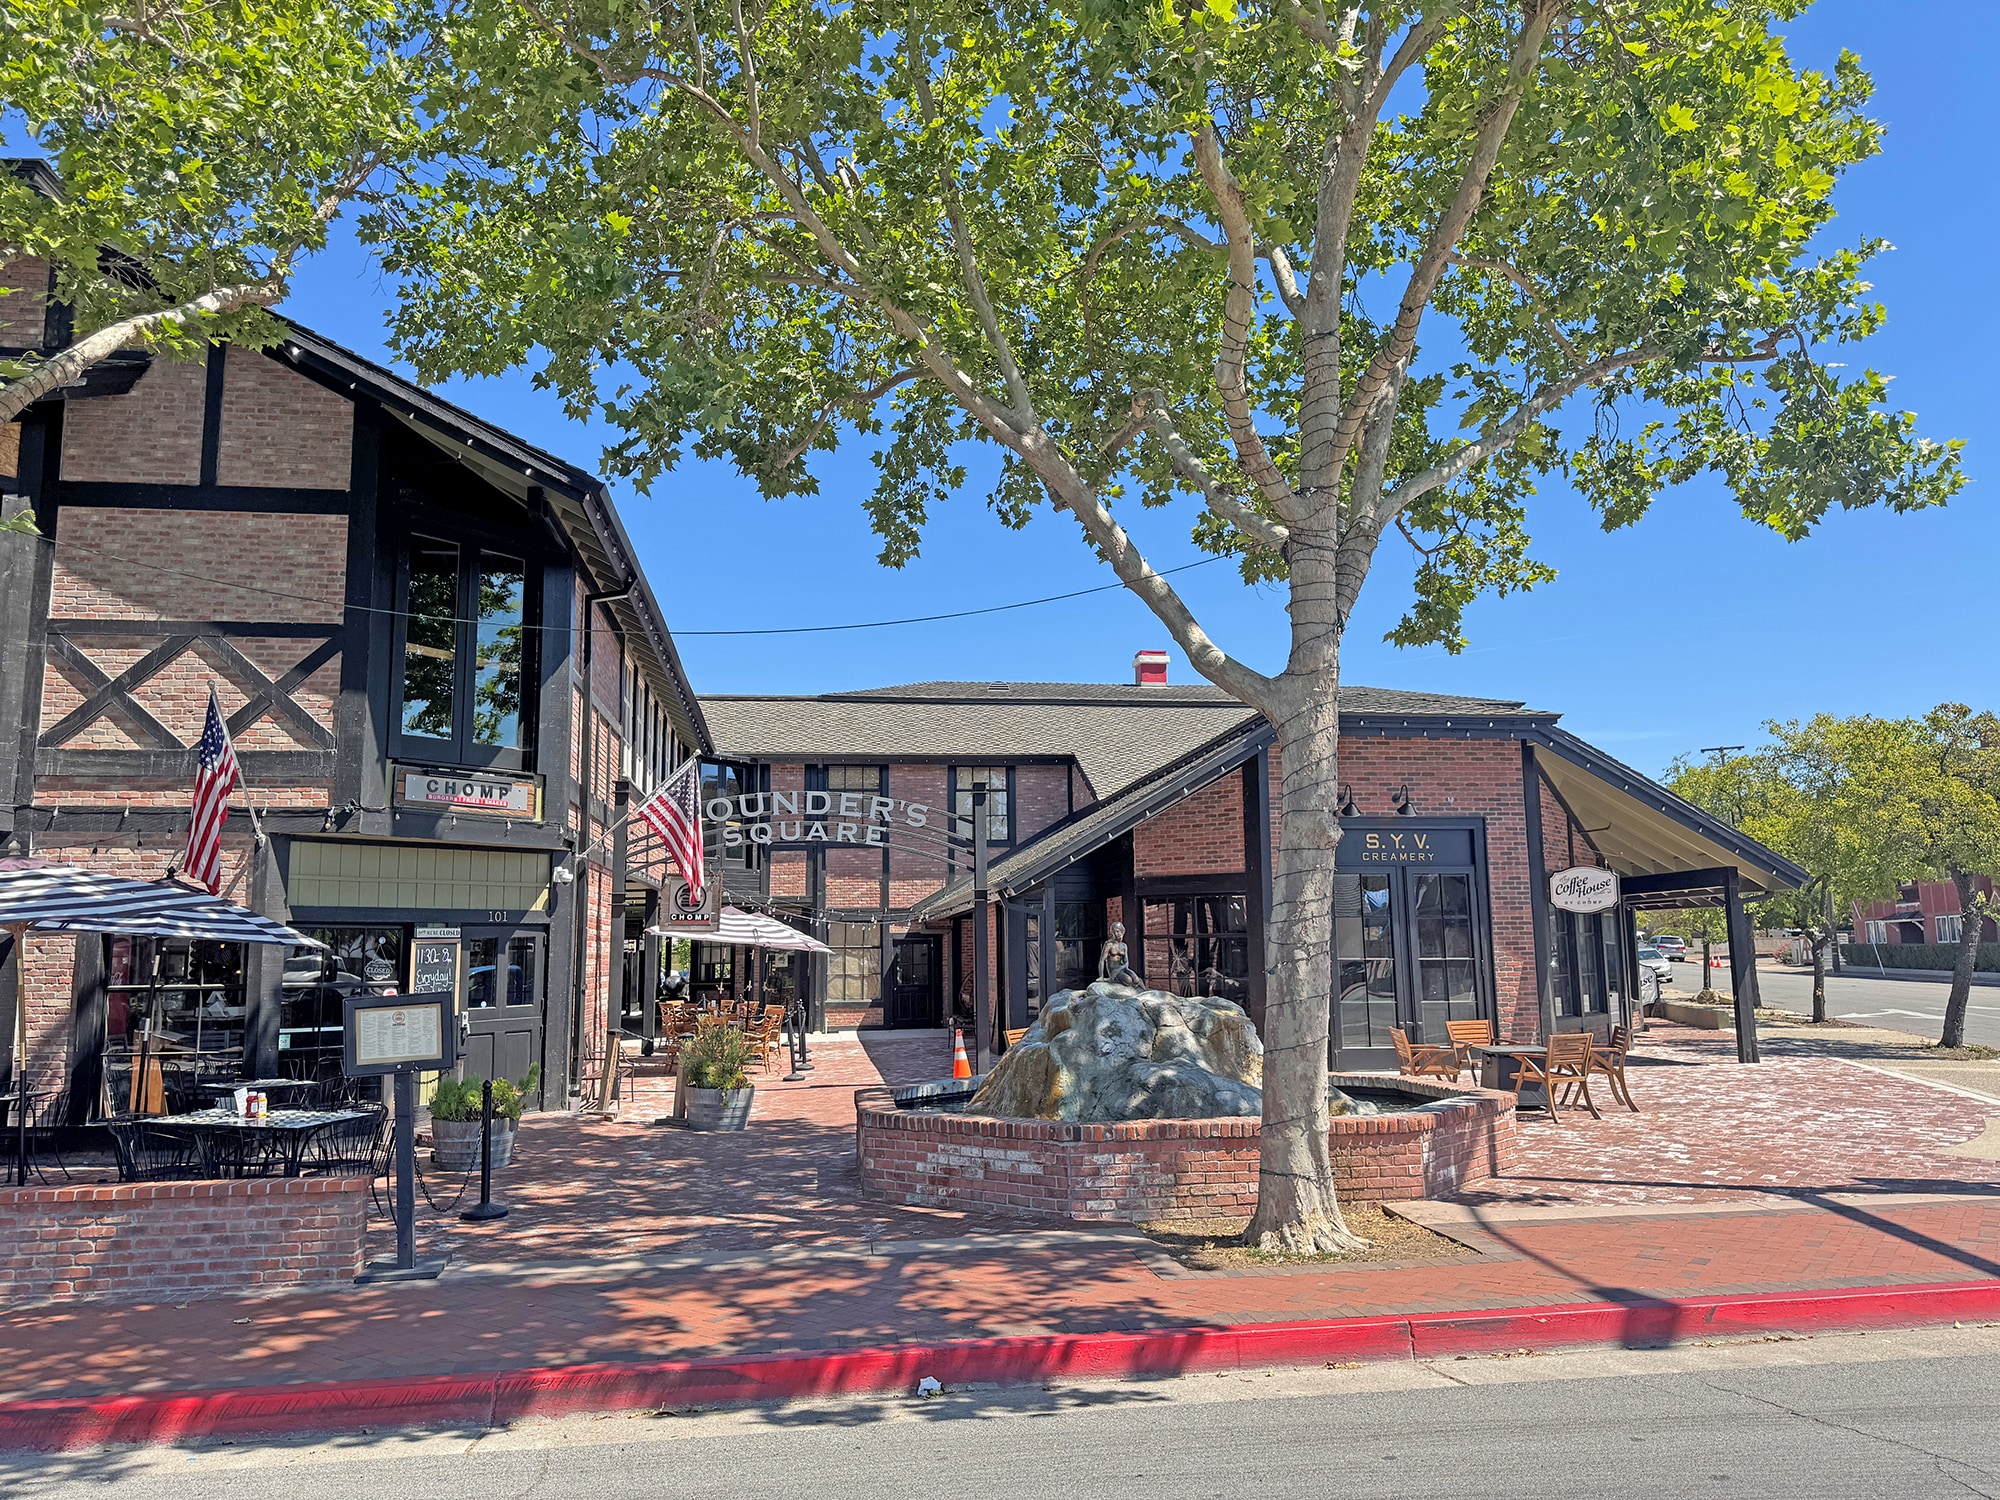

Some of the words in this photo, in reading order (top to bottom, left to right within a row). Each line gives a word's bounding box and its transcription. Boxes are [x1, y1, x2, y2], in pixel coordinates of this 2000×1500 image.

[426, 779, 509, 800] CHOMP
[428, 794, 458, 802] BURGERS
[484, 799, 507, 807] SHAKES
[706, 790, 929, 827] OUNDER'S
[722, 821, 887, 846] SQUARE
[1362, 852, 1434, 861] CREAMERY
[1555, 876, 1589, 897] Coffee
[1575, 878, 1611, 898] House
[488, 911, 508, 922] 101
[671, 913, 709, 921] CHOMP
[366, 966, 391, 974] CLOSED
